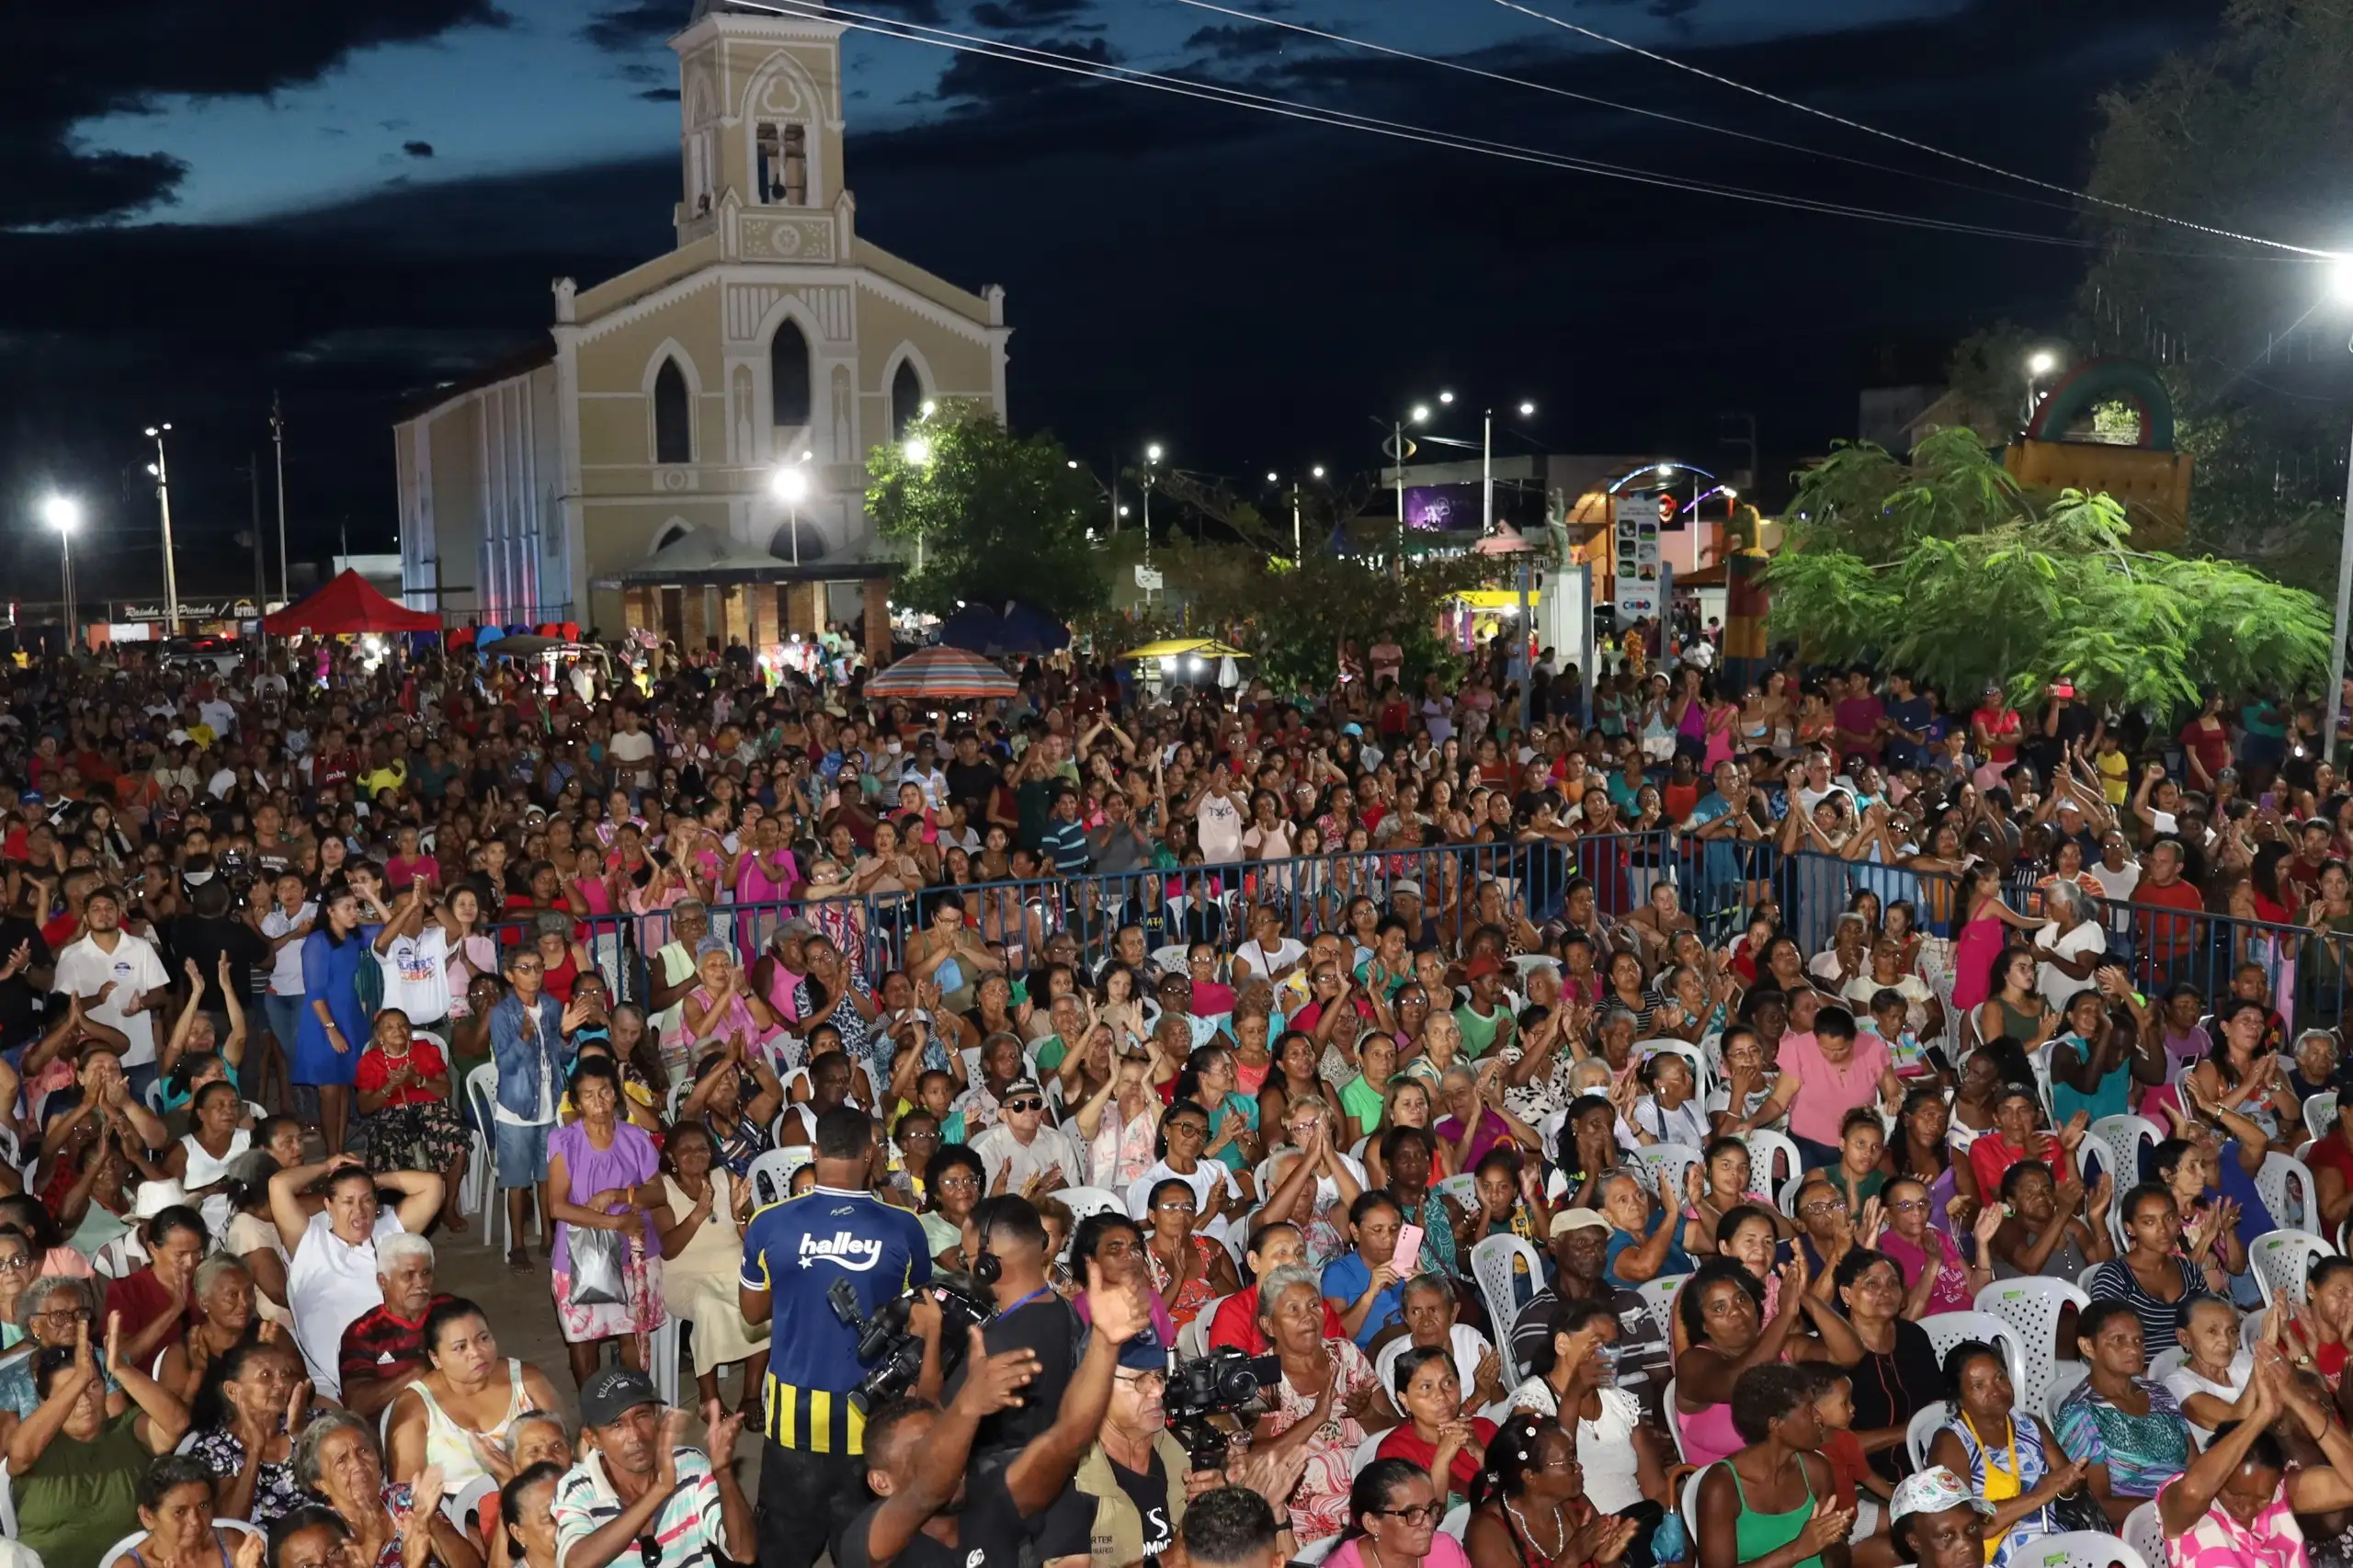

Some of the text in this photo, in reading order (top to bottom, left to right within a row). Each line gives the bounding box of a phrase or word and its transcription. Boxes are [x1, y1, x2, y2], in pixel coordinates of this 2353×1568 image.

[177, 603, 216, 616] Picanha
[326, 770, 347, 781] pixbe
[799, 1232, 882, 1271] halley
